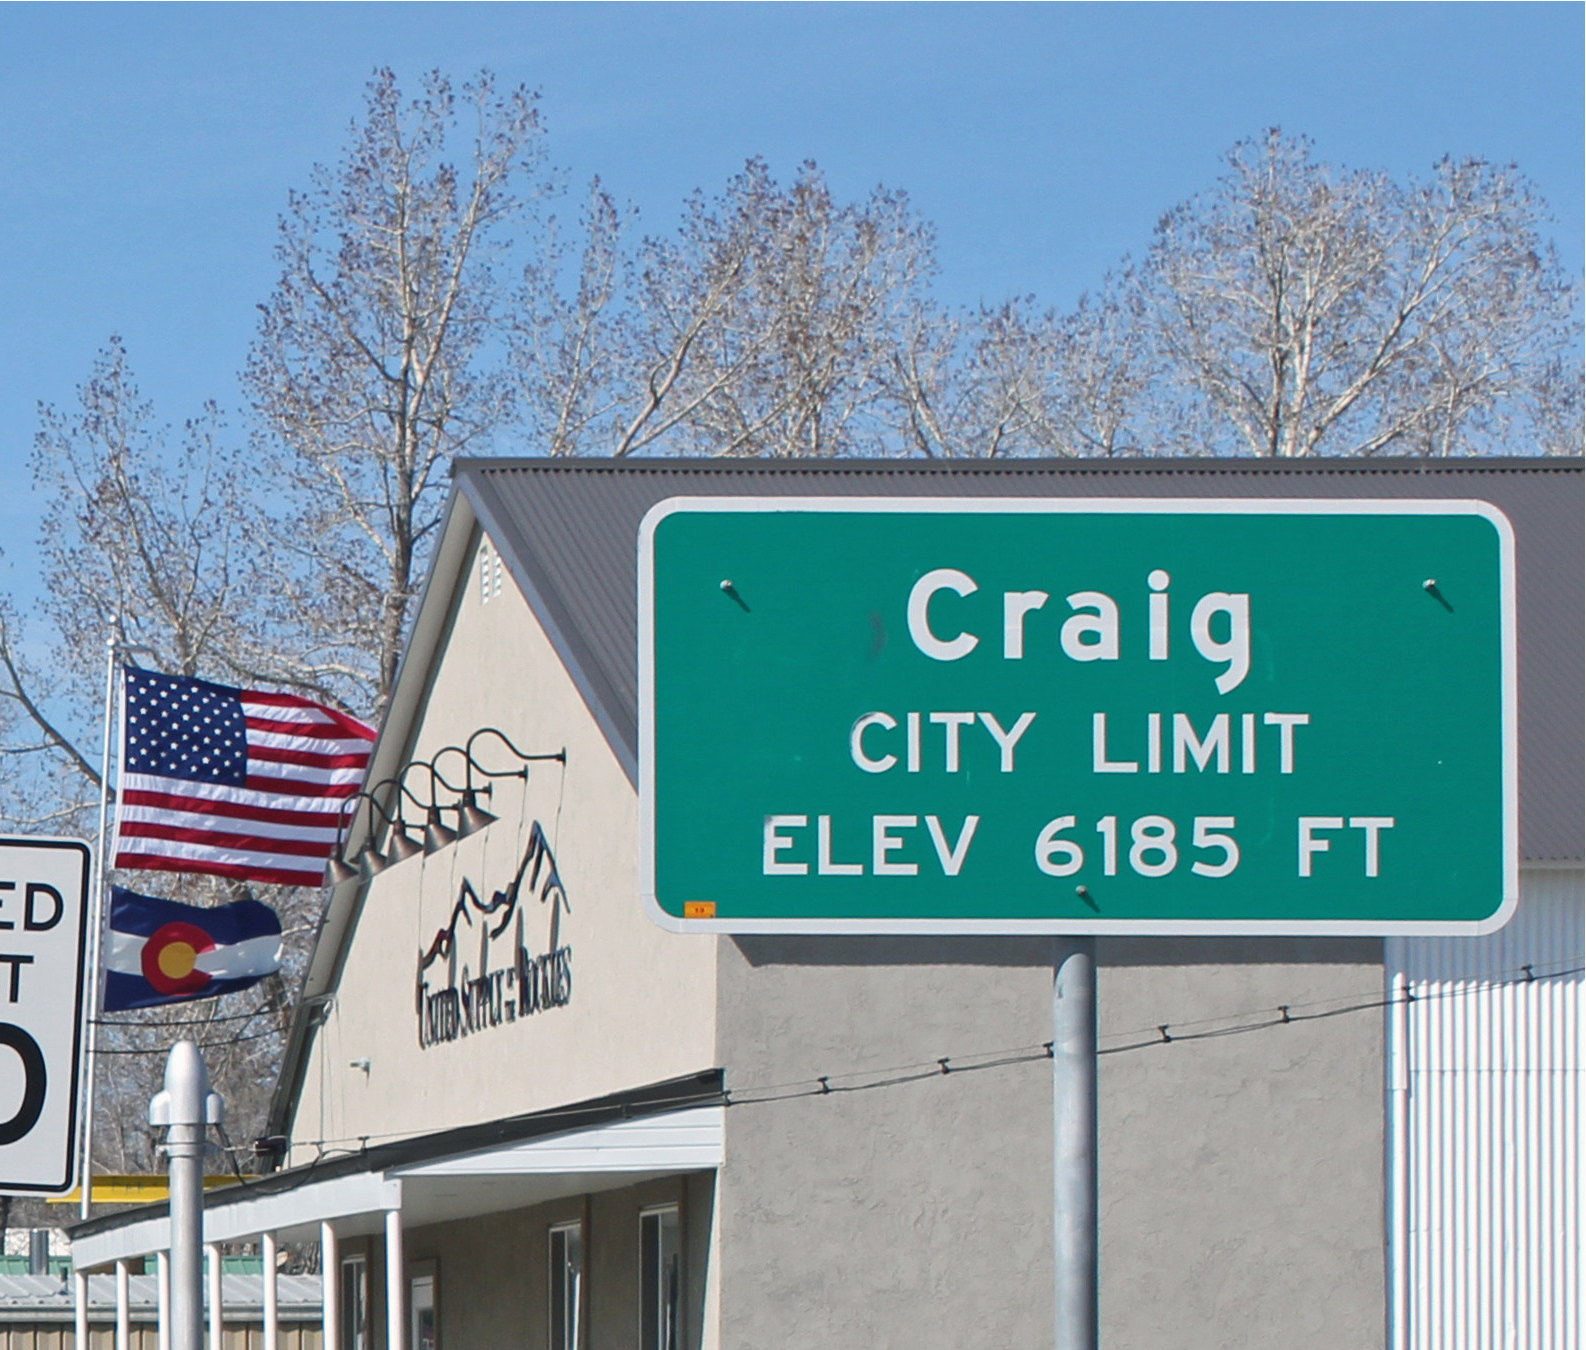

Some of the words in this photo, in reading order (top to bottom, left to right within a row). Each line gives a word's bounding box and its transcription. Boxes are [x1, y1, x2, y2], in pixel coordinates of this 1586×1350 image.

[907, 568, 1251, 695] Craig
[849, 711, 1036, 773] CITY
[1093, 713, 1310, 774] LIMIT
[763, 814, 979, 875] ELEV
[1034, 815, 1239, 877] 6185
[1298, 816, 1394, 877] FT
[415, 982, 459, 1050] UNITED
[461, 963, 504, 1037] SUPPLY
[518, 945, 572, 1017] ROCKIES
